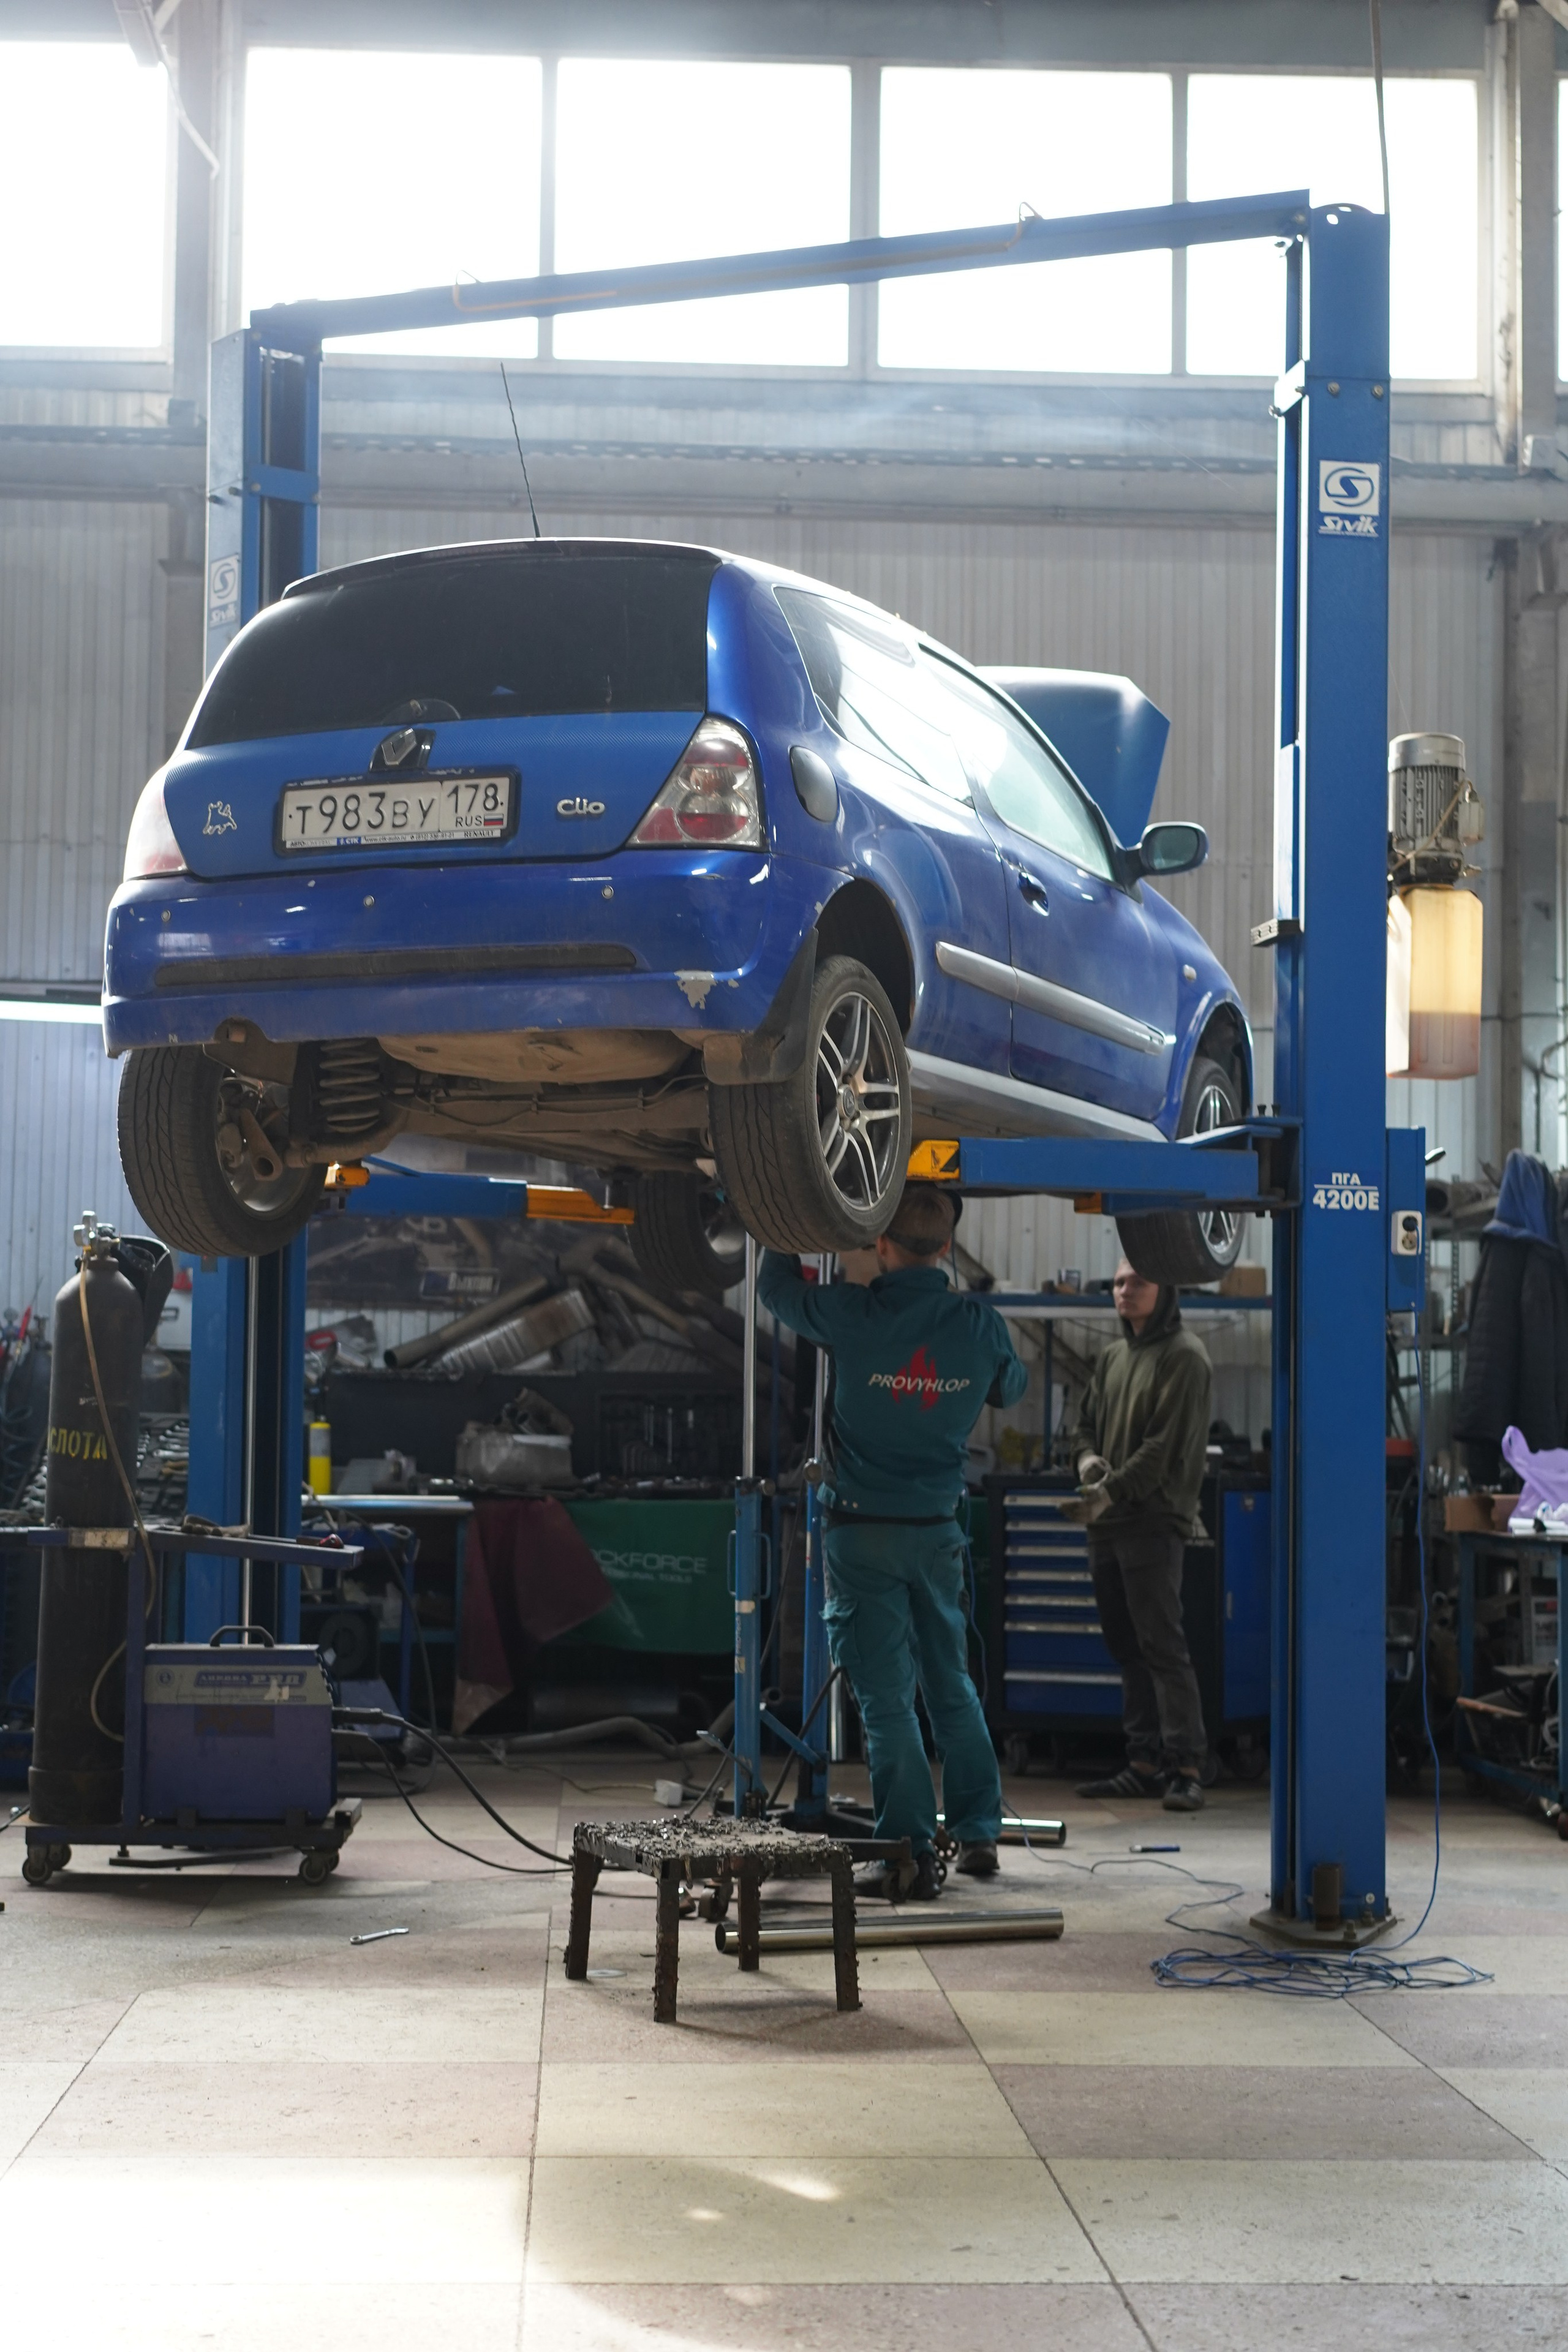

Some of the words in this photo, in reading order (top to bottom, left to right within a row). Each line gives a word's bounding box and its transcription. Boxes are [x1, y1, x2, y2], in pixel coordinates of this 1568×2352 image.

[447, 782, 500, 814] 178
[556, 797, 605, 815] Clio
[455, 814, 483, 827] RUS
[464, 829, 495, 839] RENAULT
[1332, 1172, 1361, 1186] ПГА
[868, 1373, 970, 1392] PROVYHLOP
